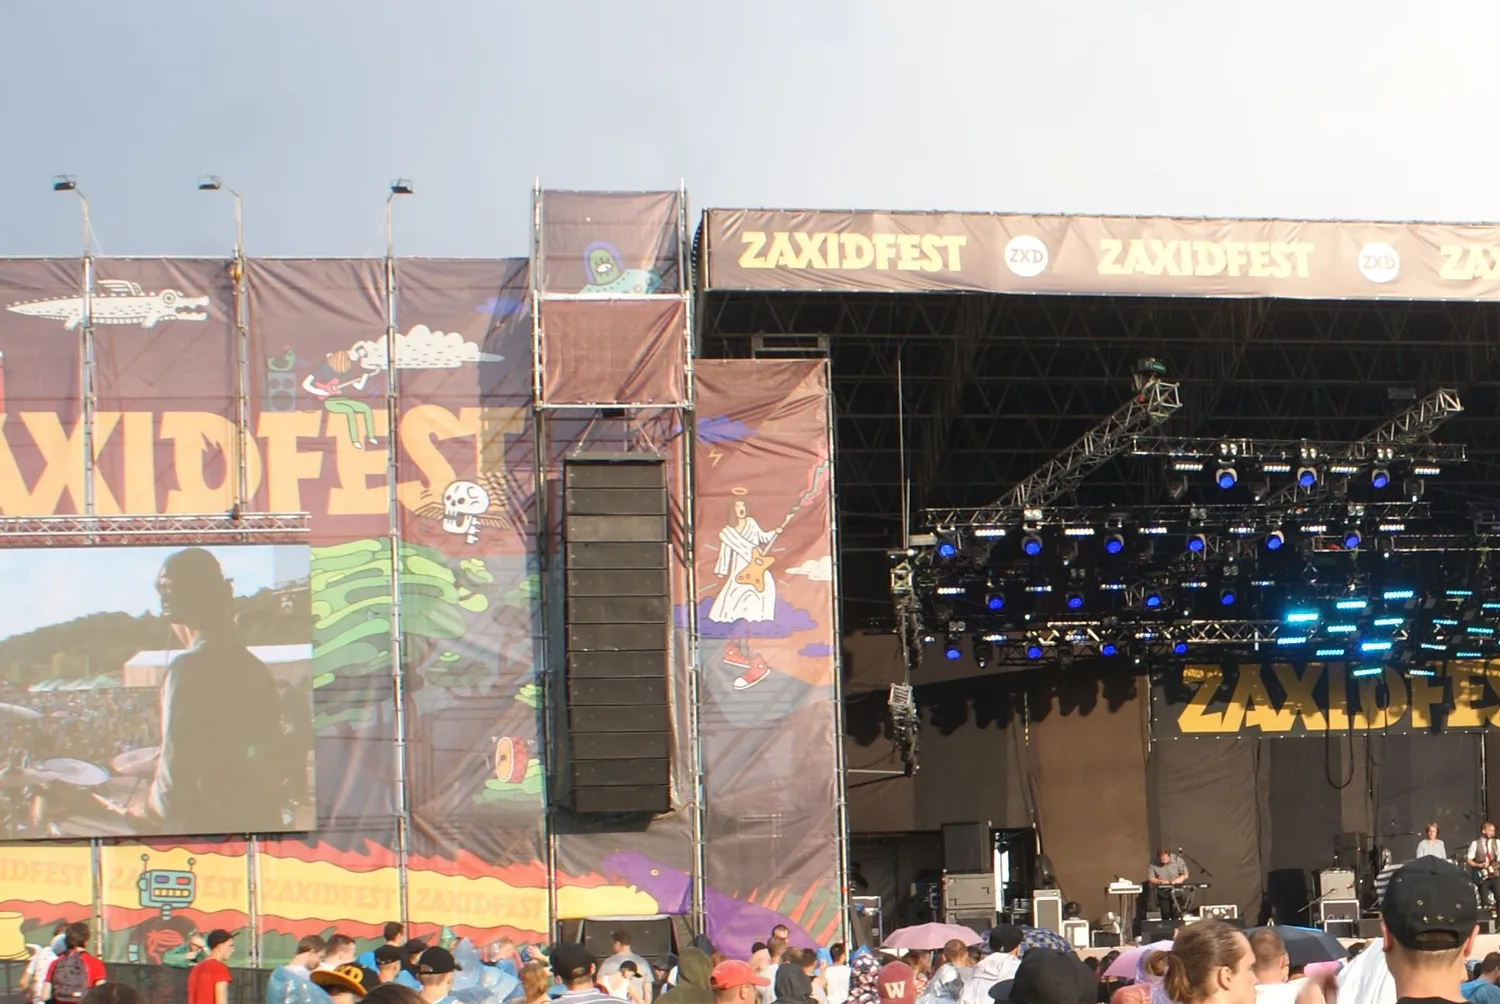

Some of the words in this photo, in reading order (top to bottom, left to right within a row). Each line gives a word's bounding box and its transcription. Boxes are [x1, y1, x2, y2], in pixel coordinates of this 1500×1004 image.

[738, 231, 967, 272] ZAXIDFEST
[1009, 248, 1043, 263] ZXD
[1096, 238, 1315, 279] ZAXIDFEST
[1363, 255, 1395, 270] ZXD
[884, 980, 906, 999] W
